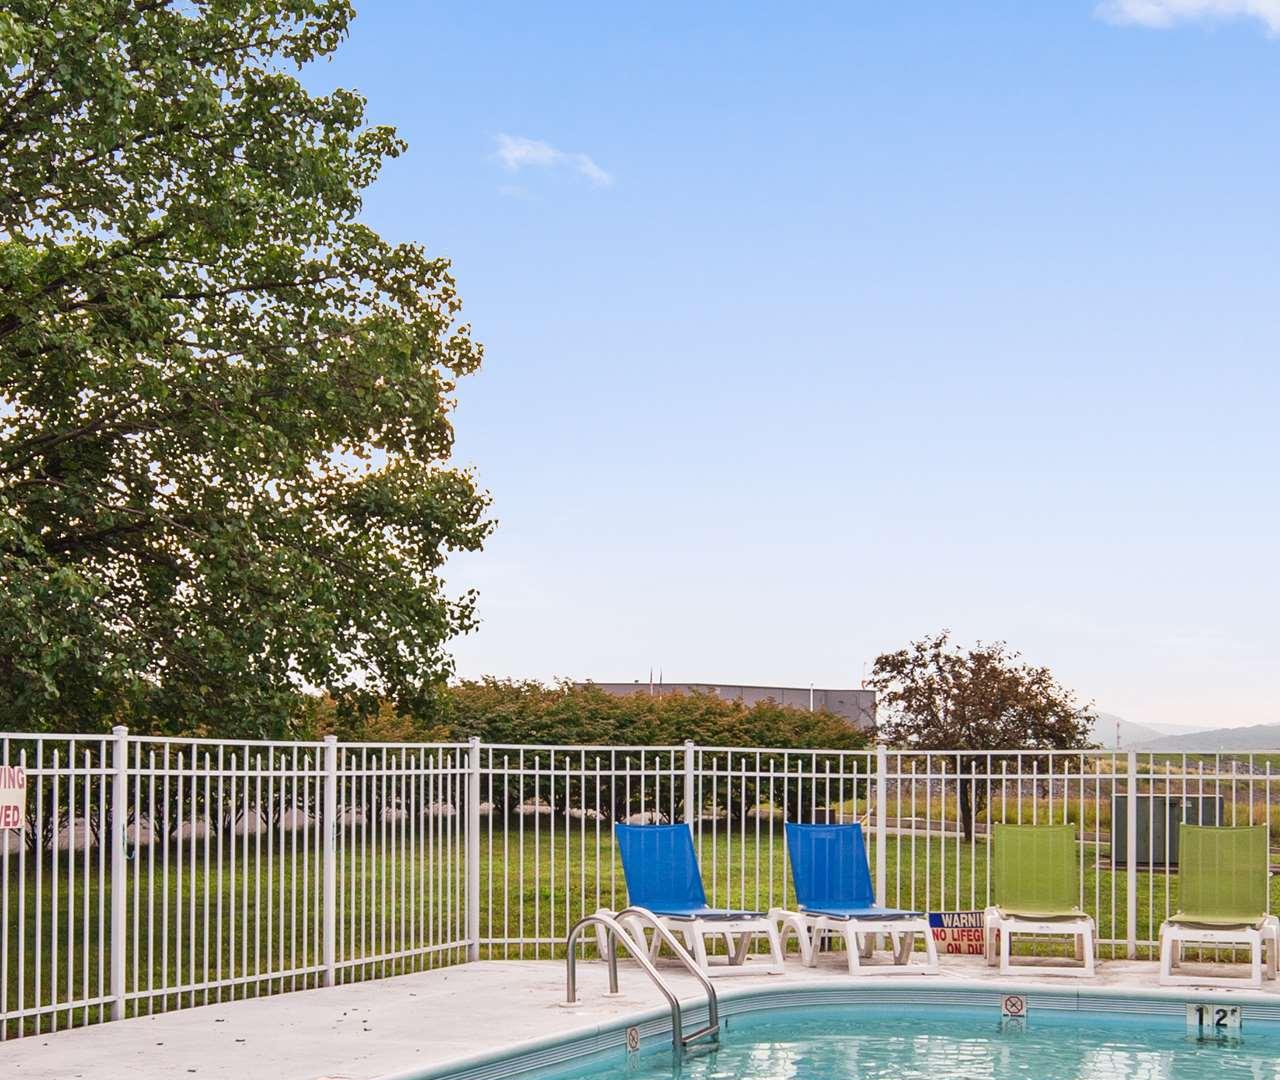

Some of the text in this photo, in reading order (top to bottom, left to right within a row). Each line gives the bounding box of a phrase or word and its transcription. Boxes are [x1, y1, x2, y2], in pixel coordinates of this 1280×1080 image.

[942, 913, 984, 928] WARNI
[932, 928, 984, 942] NO LIFEG
[947, 943, 984, 955] ON DU
